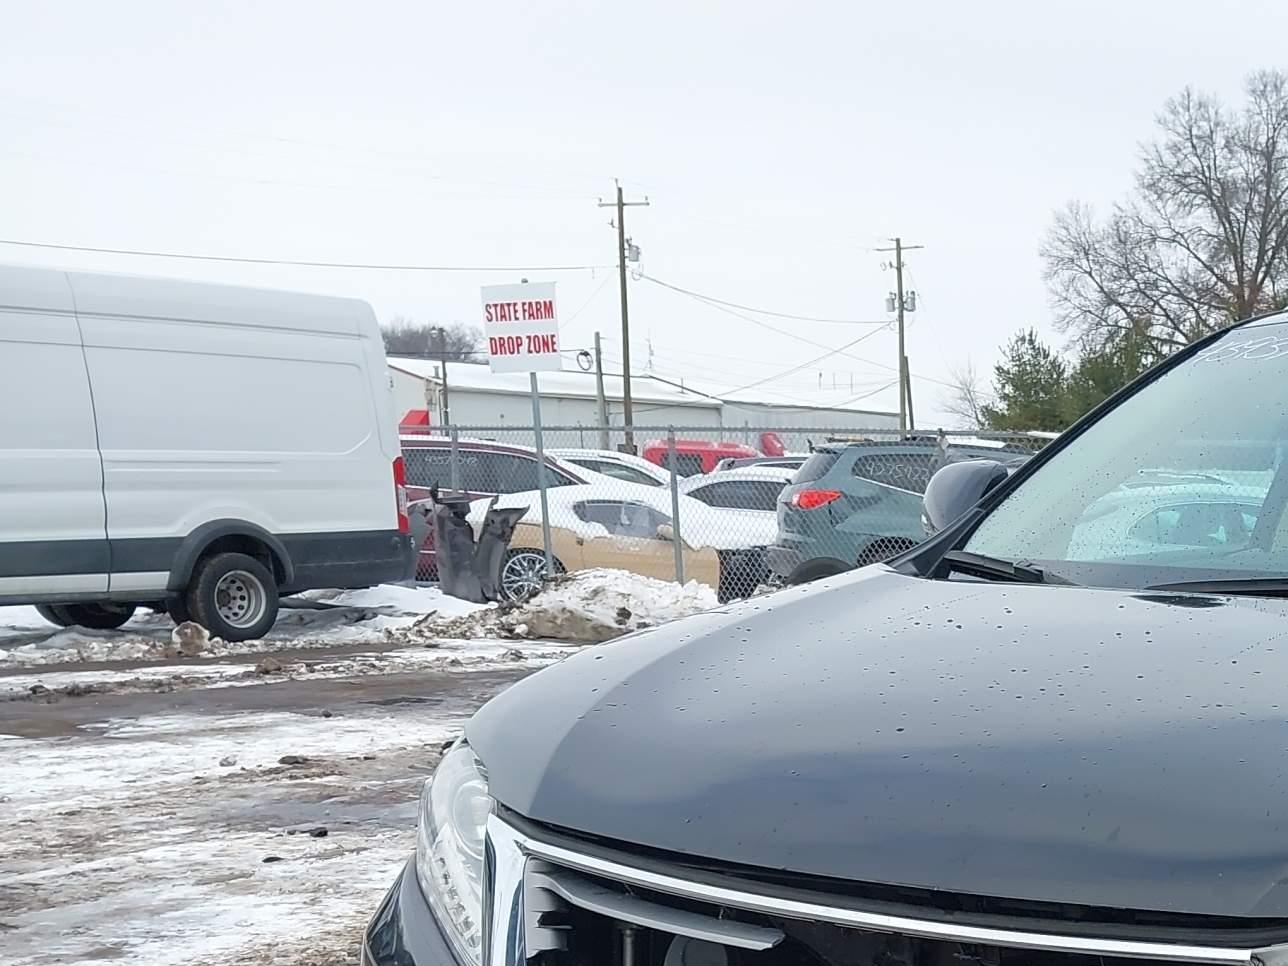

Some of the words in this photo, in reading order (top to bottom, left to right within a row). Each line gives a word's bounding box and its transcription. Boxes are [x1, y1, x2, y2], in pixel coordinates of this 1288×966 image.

[485, 302, 519, 322] STATE
[521, 300, 554, 320] FARM
[489, 335, 523, 355] DROP
[526, 333, 557, 354] ZONE
